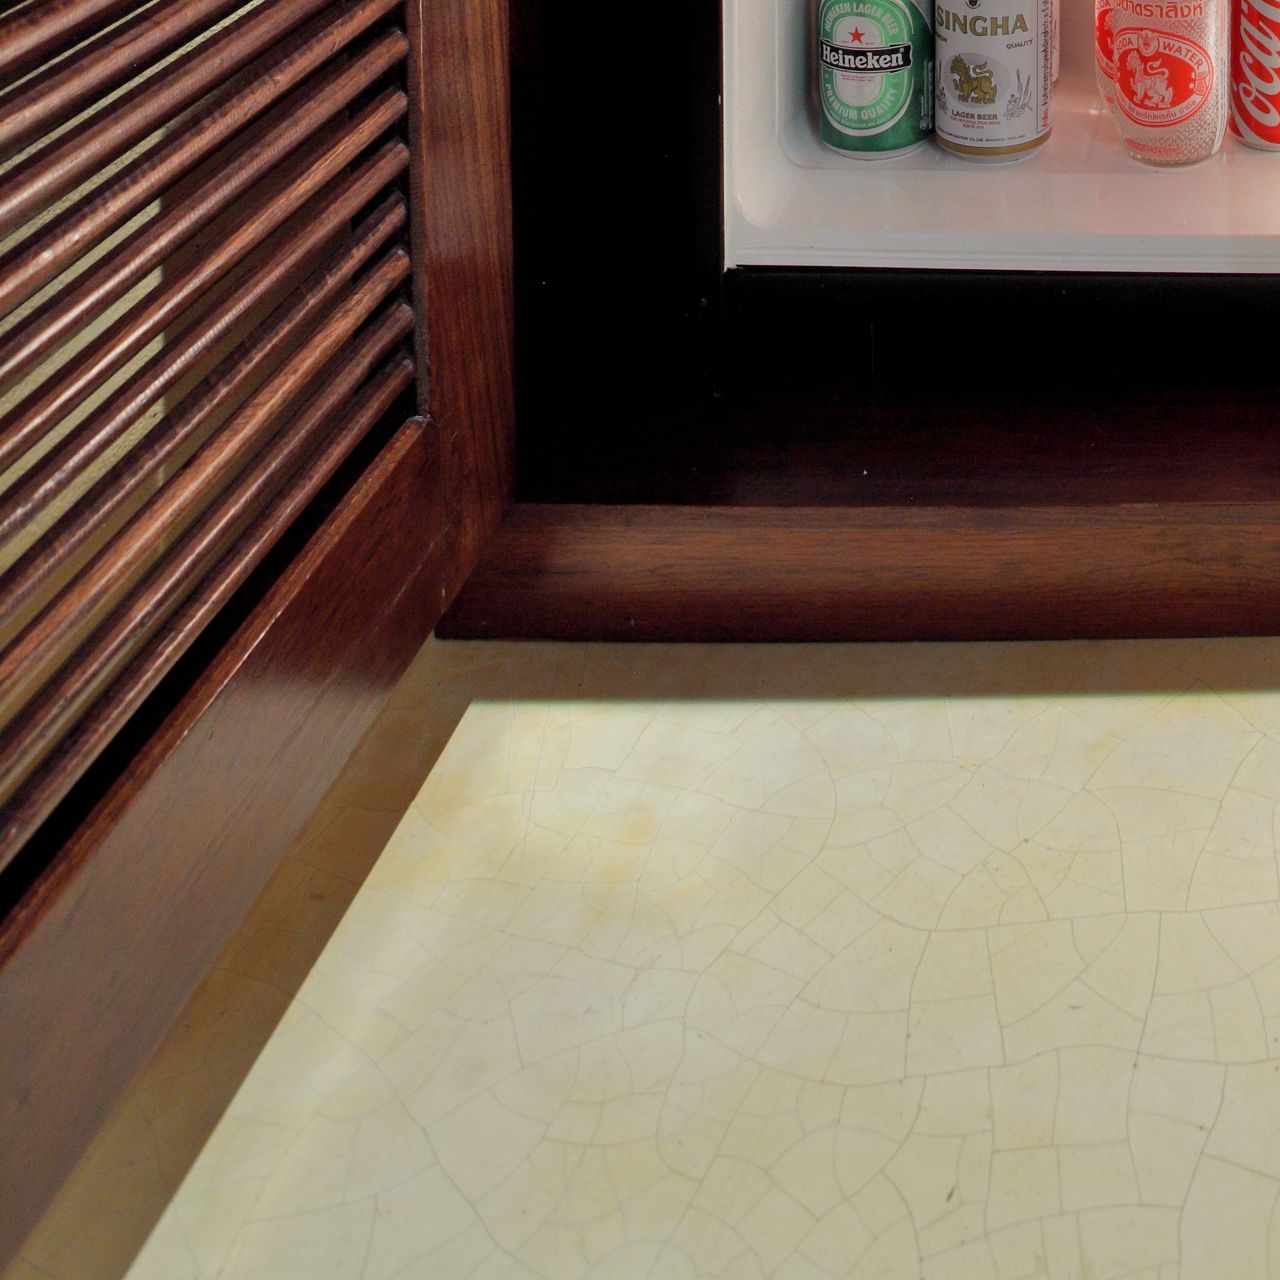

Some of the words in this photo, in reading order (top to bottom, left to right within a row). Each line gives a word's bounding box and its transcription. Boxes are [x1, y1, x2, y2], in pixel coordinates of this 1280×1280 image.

[853, 3, 884, 18] LAGER
[936, 4, 1029, 37] SINGHA
[822, 43, 904, 69] Heineken
[1006, 39, 1034, 50] QUALITY
[1162, 40, 1204, 70] WATER
[825, 83, 858, 120] PREMIUM
[861, 87, 898, 120] QUALITY
[951, 109, 976, 120] LAGER
